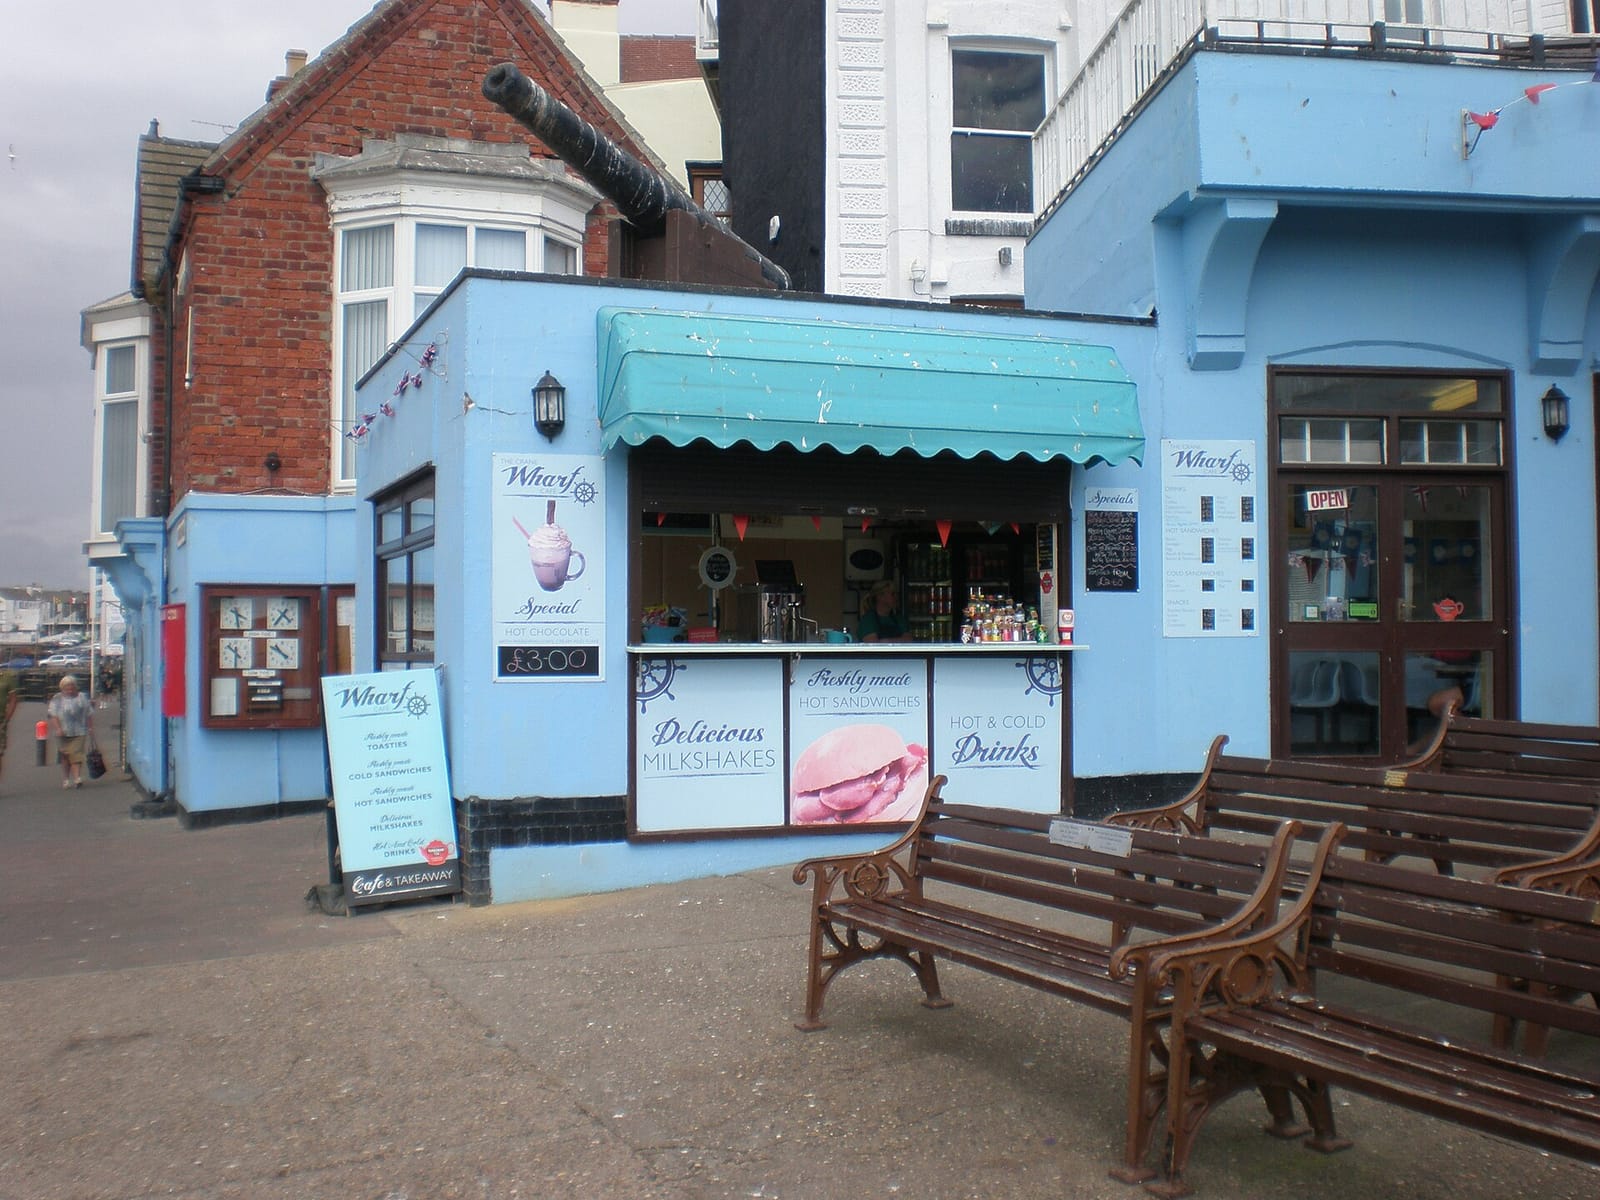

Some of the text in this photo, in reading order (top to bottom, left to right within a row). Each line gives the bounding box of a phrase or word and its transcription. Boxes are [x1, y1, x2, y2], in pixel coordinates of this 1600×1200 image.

[1171, 448, 1242, 474] Wharf
[501, 464, 585, 494] Wharf
[1088, 490, 1135, 508] Specials
[1311, 491, 1345, 508] OPEN
[515, 597, 582, 620] Special
[505, 627, 590, 637] HOT CHOCOLATE
[808, 668, 912, 694] Freshly made
[333, 680, 416, 710] Wharf
[799, 696, 921, 708] HOT SANDWICHES
[950, 715, 1046, 729] HOT & COLD
[652, 717, 765, 747] Delicious
[367, 740, 408, 751] TOASTIES
[951, 732, 1040, 770] Drinks
[643, 749, 776, 771] MILKSHAKES
[348, 766, 432, 781] COLD SANDWICHES
[354, 792, 433, 808] HOT SANDWICHES
[369, 819, 424, 832] MILKSHAKES
[383, 847, 417, 858] DRINKS
[352, 869, 454, 895] Cafe & TAKEAWAY
